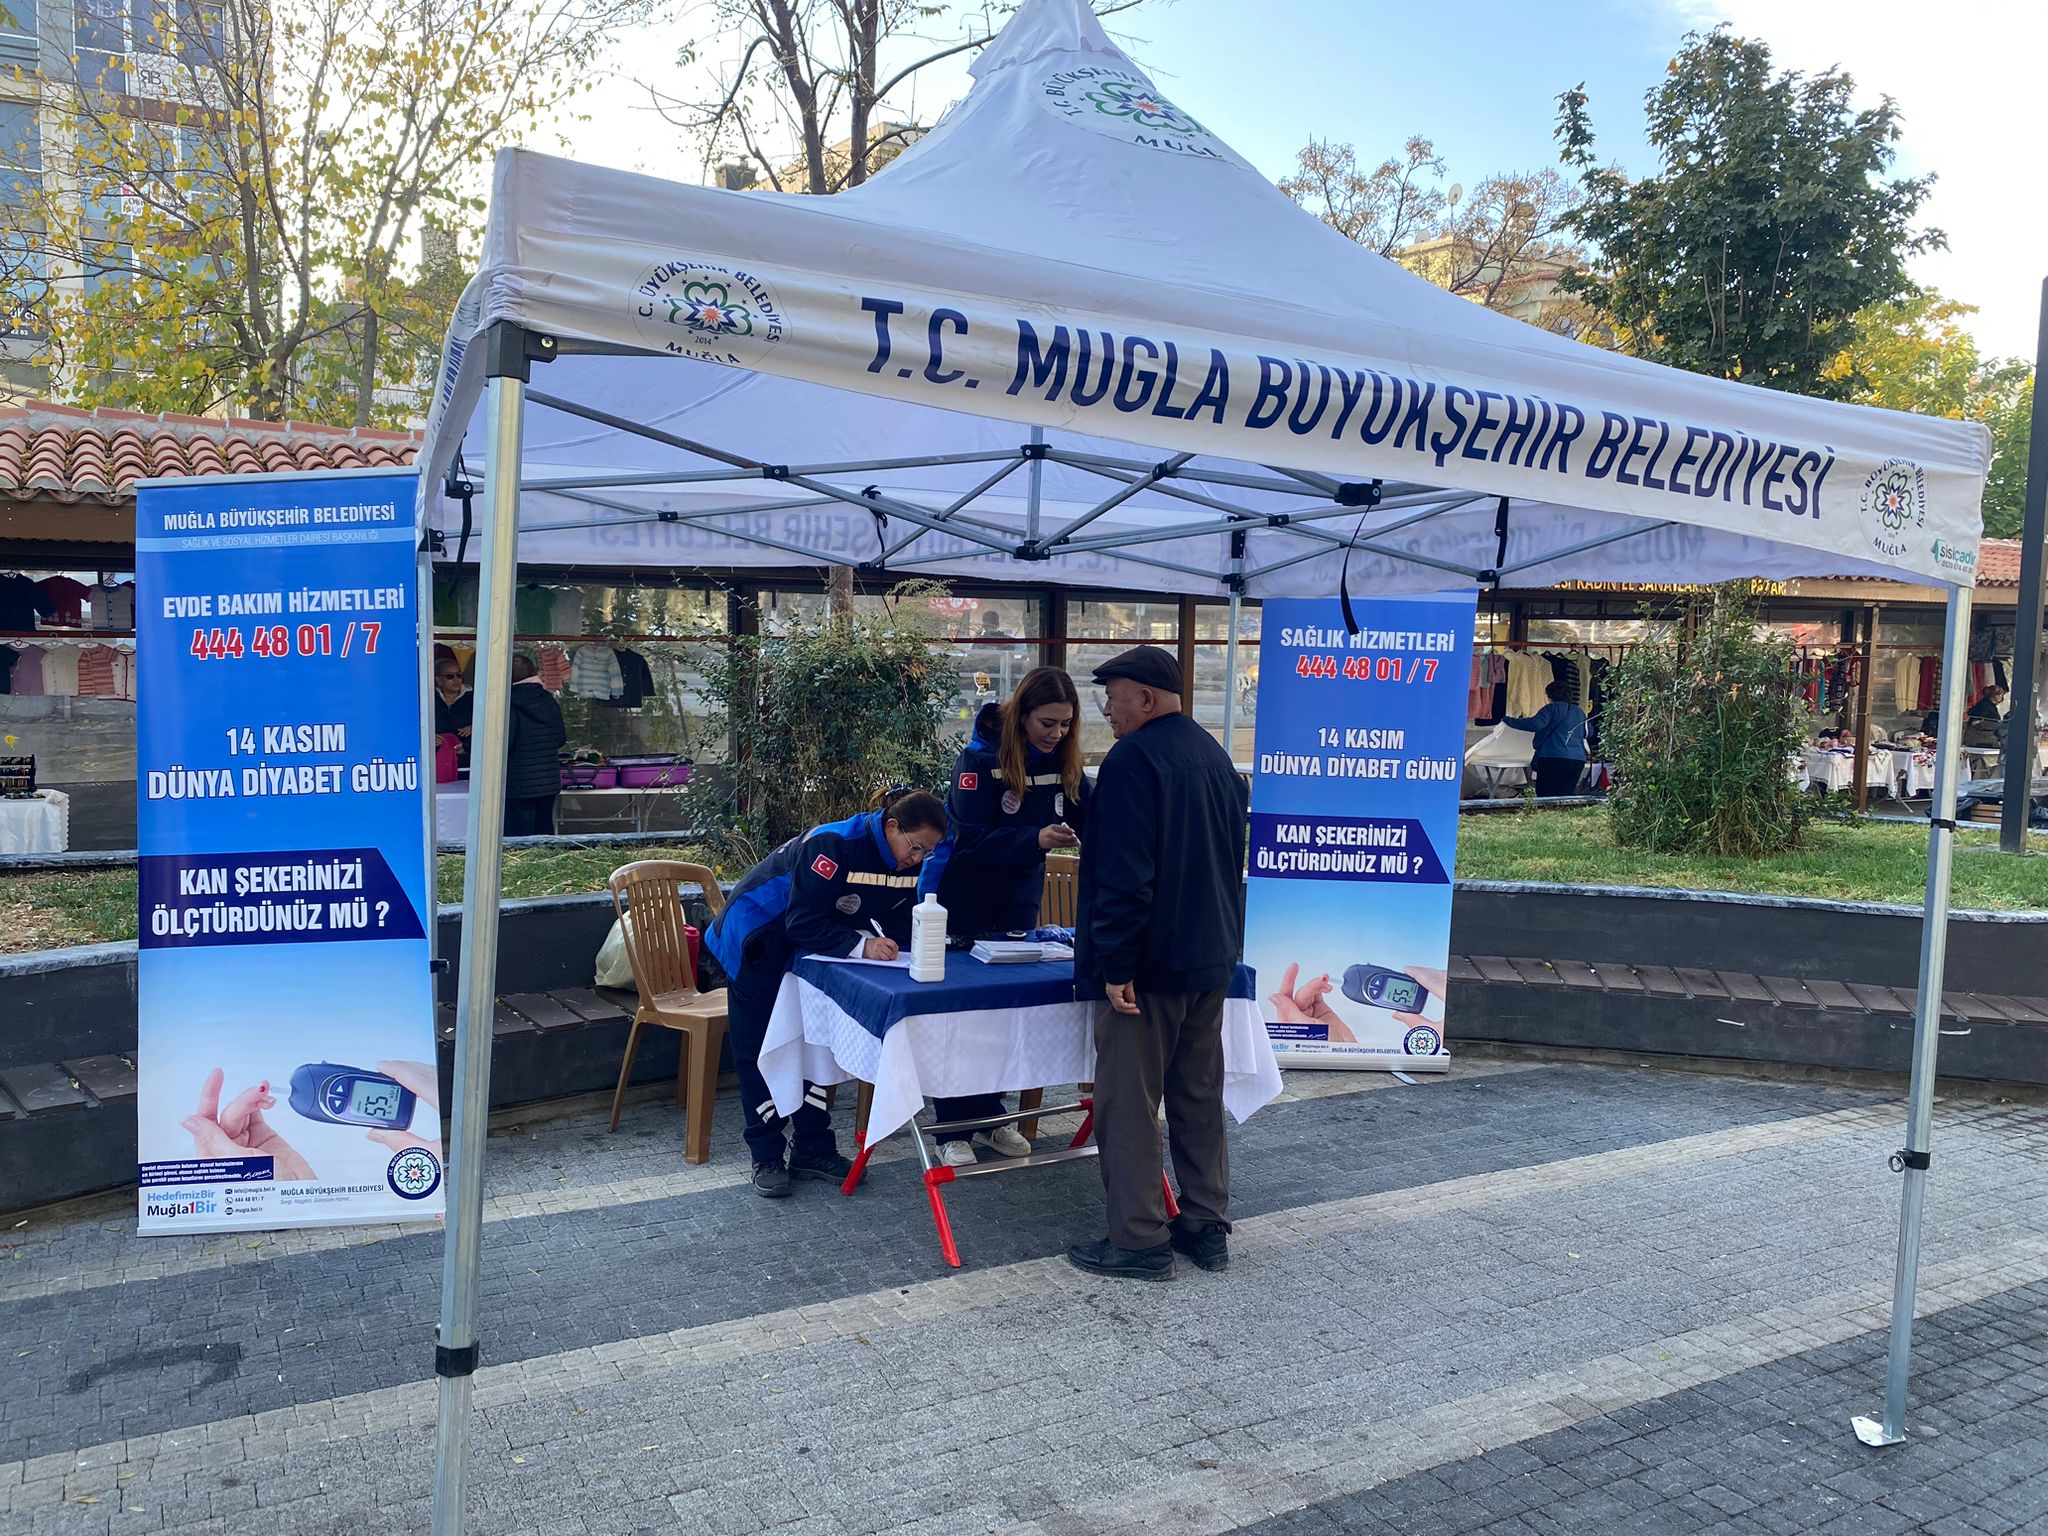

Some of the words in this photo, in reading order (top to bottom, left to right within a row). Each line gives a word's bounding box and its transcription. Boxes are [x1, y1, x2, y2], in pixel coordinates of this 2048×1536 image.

[860, 297, 980, 389] T.C.
[1585, 410, 1836, 520] BELEDİYESİ
[164, 510, 216, 530] MUĞLA
[220, 505, 309, 527] BÜYÜKŞEHİR
[313, 501, 395, 523] BELEDİYESİ
[182, 538, 210, 549] SAĞLIK
[212, 538, 221, 547] VE
[223, 536, 253, 546] SOSYAL
[332, 529, 379, 543] BAŞKANLIĞI
[163, 595, 212, 618] EVDE
[217, 592, 282, 617] BAKIM
[288, 583, 405, 613] HİZMETLERİ
[191, 628, 244, 660] 444
[252, 625, 289, 658] 48
[297, 623, 332, 656] 01
[361, 622, 382, 654] 7
[1280, 625, 1344, 649] SAĞLIK
[1350, 627, 1455, 652] HİZMETLERİ
[1296, 655, 1337, 679] 444
[1343, 657, 1370, 680] 48
[1376, 658, 1402, 681] 01
[1424, 659, 1439, 682] 7
[226, 727, 256, 756] 14
[264, 723, 346, 754] KASIM
[1318, 727, 1339, 748] 14
[1345, 728, 1405, 750] KASIM
[148, 765, 235, 799] DÜNYA
[242, 762, 344, 796] DİYABET
[351, 757, 418, 793] GÜNÜ
[1260, 751, 1321, 776] DÜNYA
[1326, 753, 1401, 779] DİYABET
[1405, 756, 1457, 781] GÜNÜ
[1276, 824, 1311, 844] KAN
[1315, 823, 1407, 848] ŞEKERİNİZİ
[1257, 847, 1376, 874] ÖLÇTÜRDÜNÜZ
[1380, 852, 1408, 874] MÜ
[1412, 856, 1424, 875] ?
[180, 868, 227, 895] KAN
[235, 858, 363, 897] ŞEKERİNİZİ
[151, 898, 322, 938] ÖLÇTÜRDÜNÜZ
[329, 897, 368, 929] MÜ
[375, 901, 390, 927] ?
[147, 1190, 216, 1202] HedefimizBir
[280, 1187, 304, 1197] MUĞLA
[305, 1186, 346, 1196] BÜYÜKŞEHİR
[347, 1184, 384, 1193] BELEDİYESİ
[147, 1200, 217, 1218] Muğla1Bir
